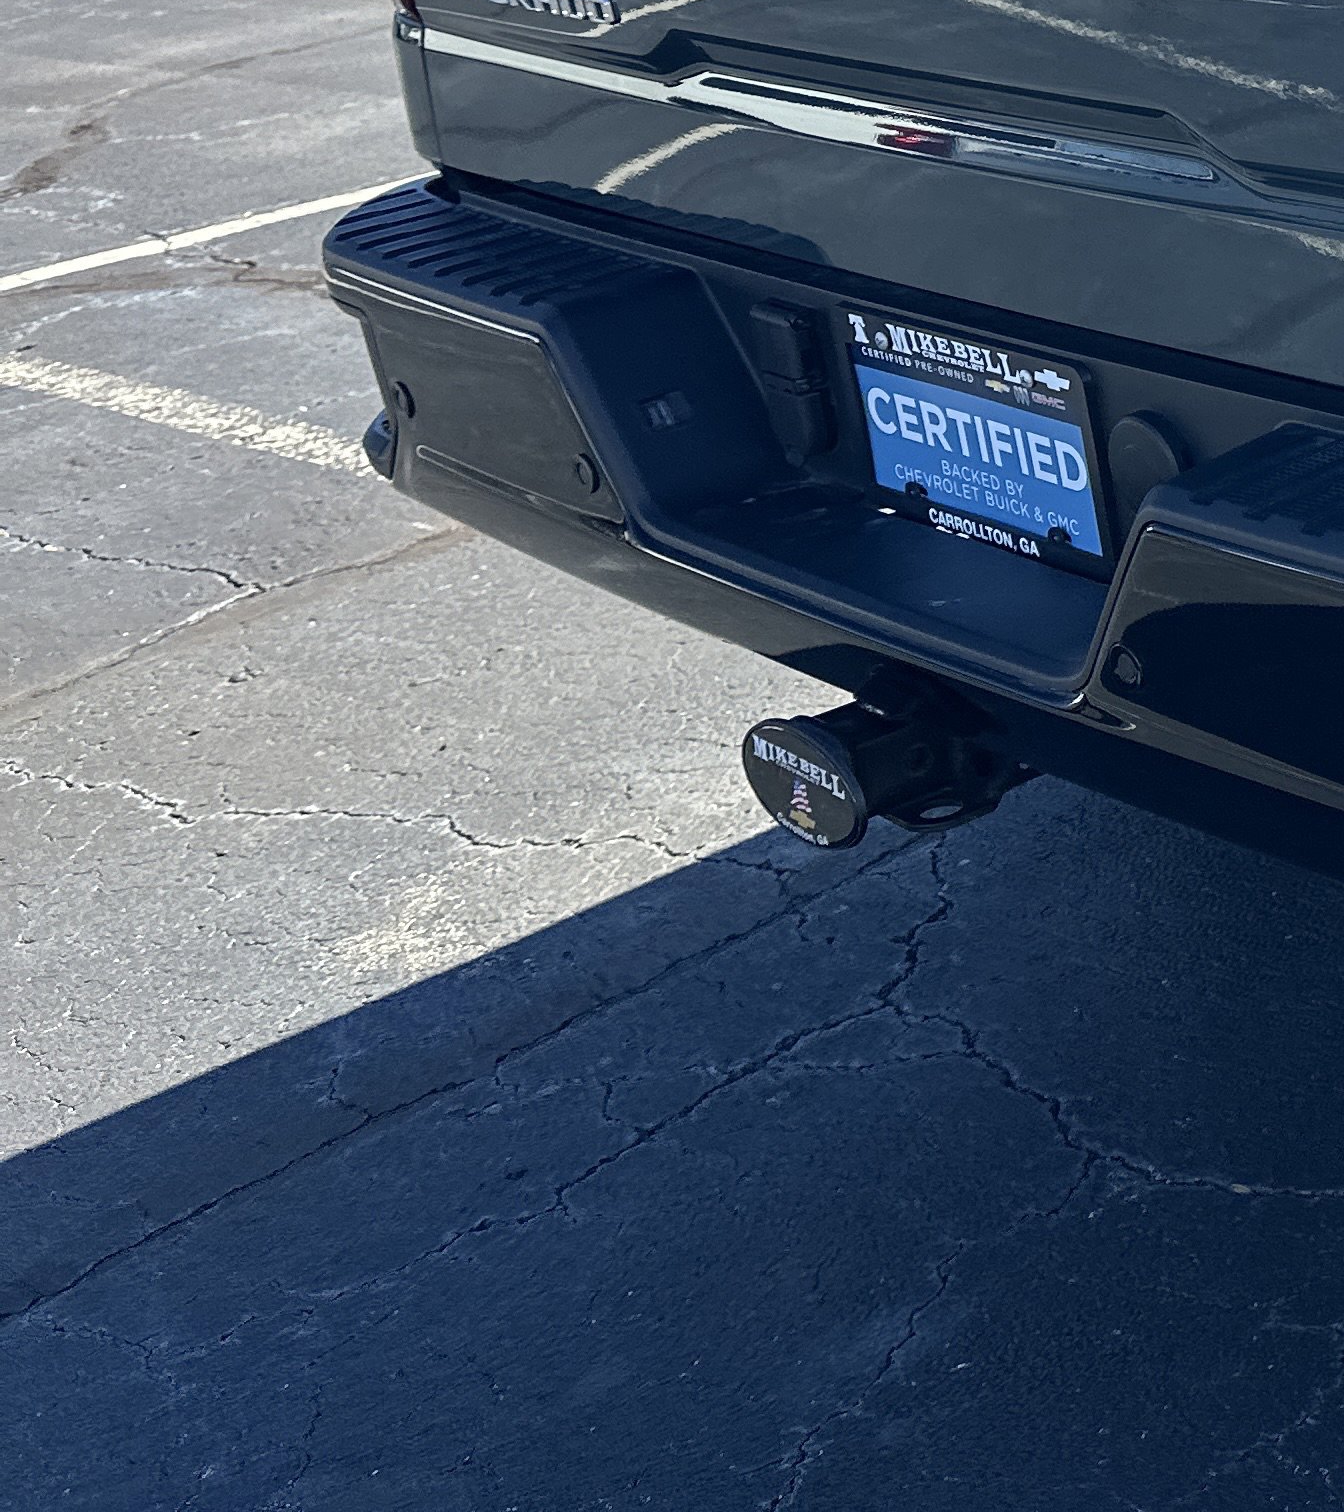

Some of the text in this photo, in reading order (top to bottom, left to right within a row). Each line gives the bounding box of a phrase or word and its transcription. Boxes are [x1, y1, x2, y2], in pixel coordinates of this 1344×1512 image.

[861, 346, 974, 384] CERTIFIED PRE-OWNED
[885, 323, 1021, 385] MIKE BELL
[1031, 391, 1066, 410] GMC
[867, 387, 1088, 492] CERTIFIED
[894, 463, 1080, 536] CHEVROLET BUICK & GMC
[941, 459, 1024, 499] BACKED BY
[928, 507, 1040, 558] CARROLLTON, GA
[752, 733, 846, 801] MIKE BELL
